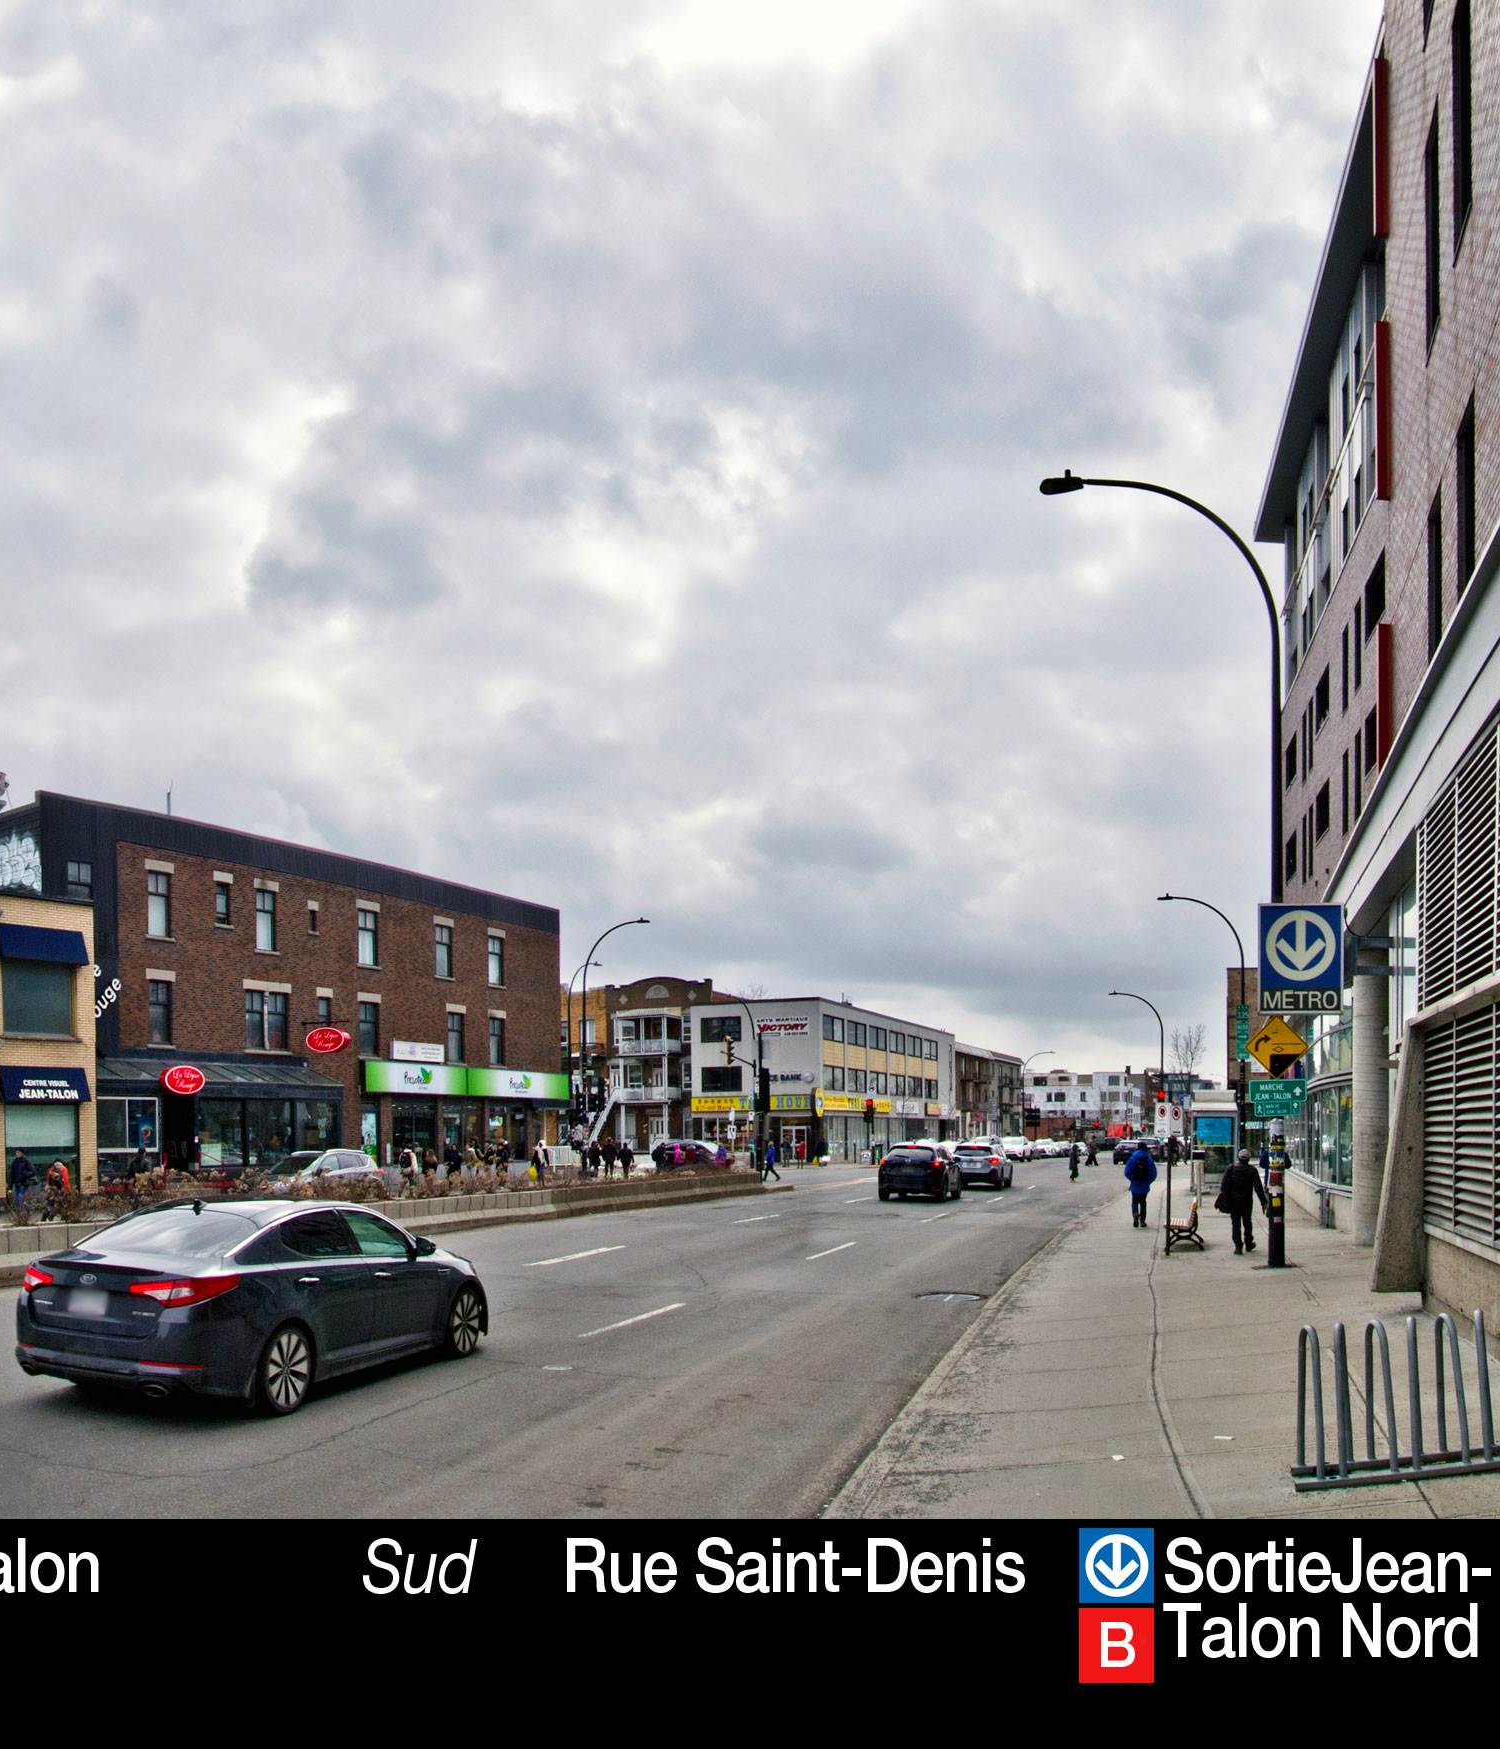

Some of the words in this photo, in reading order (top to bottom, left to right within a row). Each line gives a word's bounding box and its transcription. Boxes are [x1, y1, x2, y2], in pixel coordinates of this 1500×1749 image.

[757, 1023, 808, 1032] VICTORY
[172, 1070, 182, 1078] La
[184, 1070, 200, 1079] Ligue
[780, 1073, 802, 1081] BANK
[23, 1079, 47, 1087] CENTRE
[175, 1080, 196, 1092] Rouge
